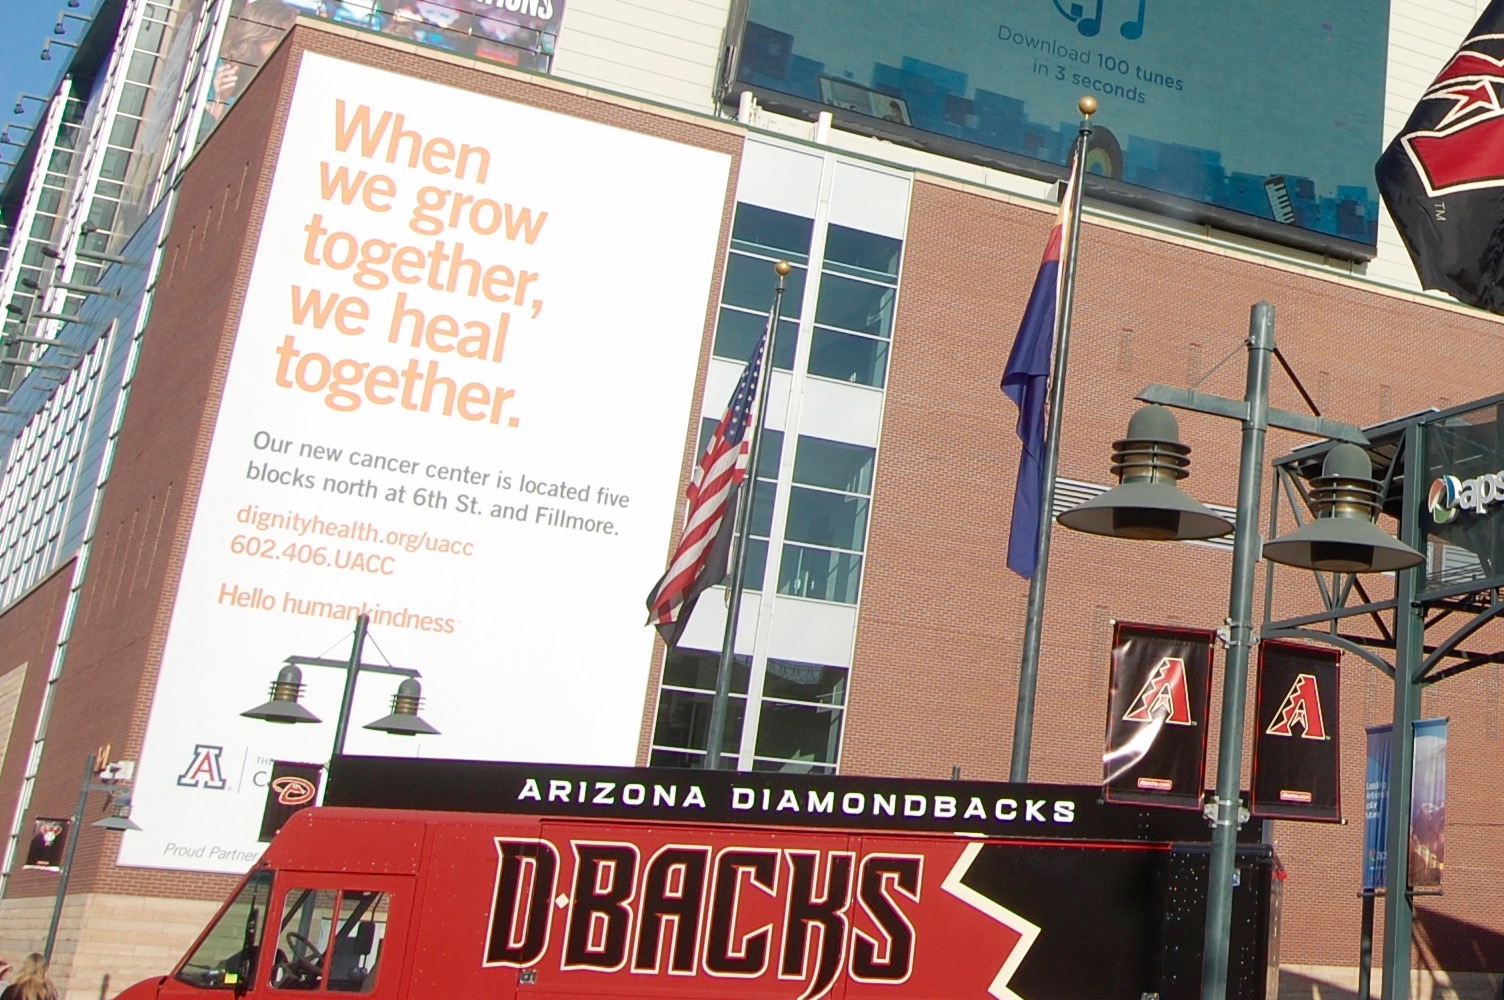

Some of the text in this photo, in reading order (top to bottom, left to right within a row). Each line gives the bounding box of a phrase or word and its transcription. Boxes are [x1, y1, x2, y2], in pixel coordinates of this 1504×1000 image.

[997, 24, 1185, 92] Download 100 tunes
[1032, 59, 1146, 105] in 3 seconds
[333, 97, 491, 185] When
[319, 160, 549, 246] we grow
[302, 213, 544, 320] together,
[291, 284, 511, 364] we heal
[274, 334, 522, 428] together.
[246, 460, 620, 537] blocks north at 6th St. and Fillmore.
[253, 430, 630, 509] Our new cancer center is located five
[229, 535, 396, 577] 602.406.UACC
[236, 504, 474, 557] dignityhealth.org/uacc
[218, 583, 456, 636] Hello humankindness
[176, 744, 227, 790] A
[518, 778, 1076, 824] ARIZONA DIAMONDBACKS
[163, 842, 259, 863] Proud Partner
